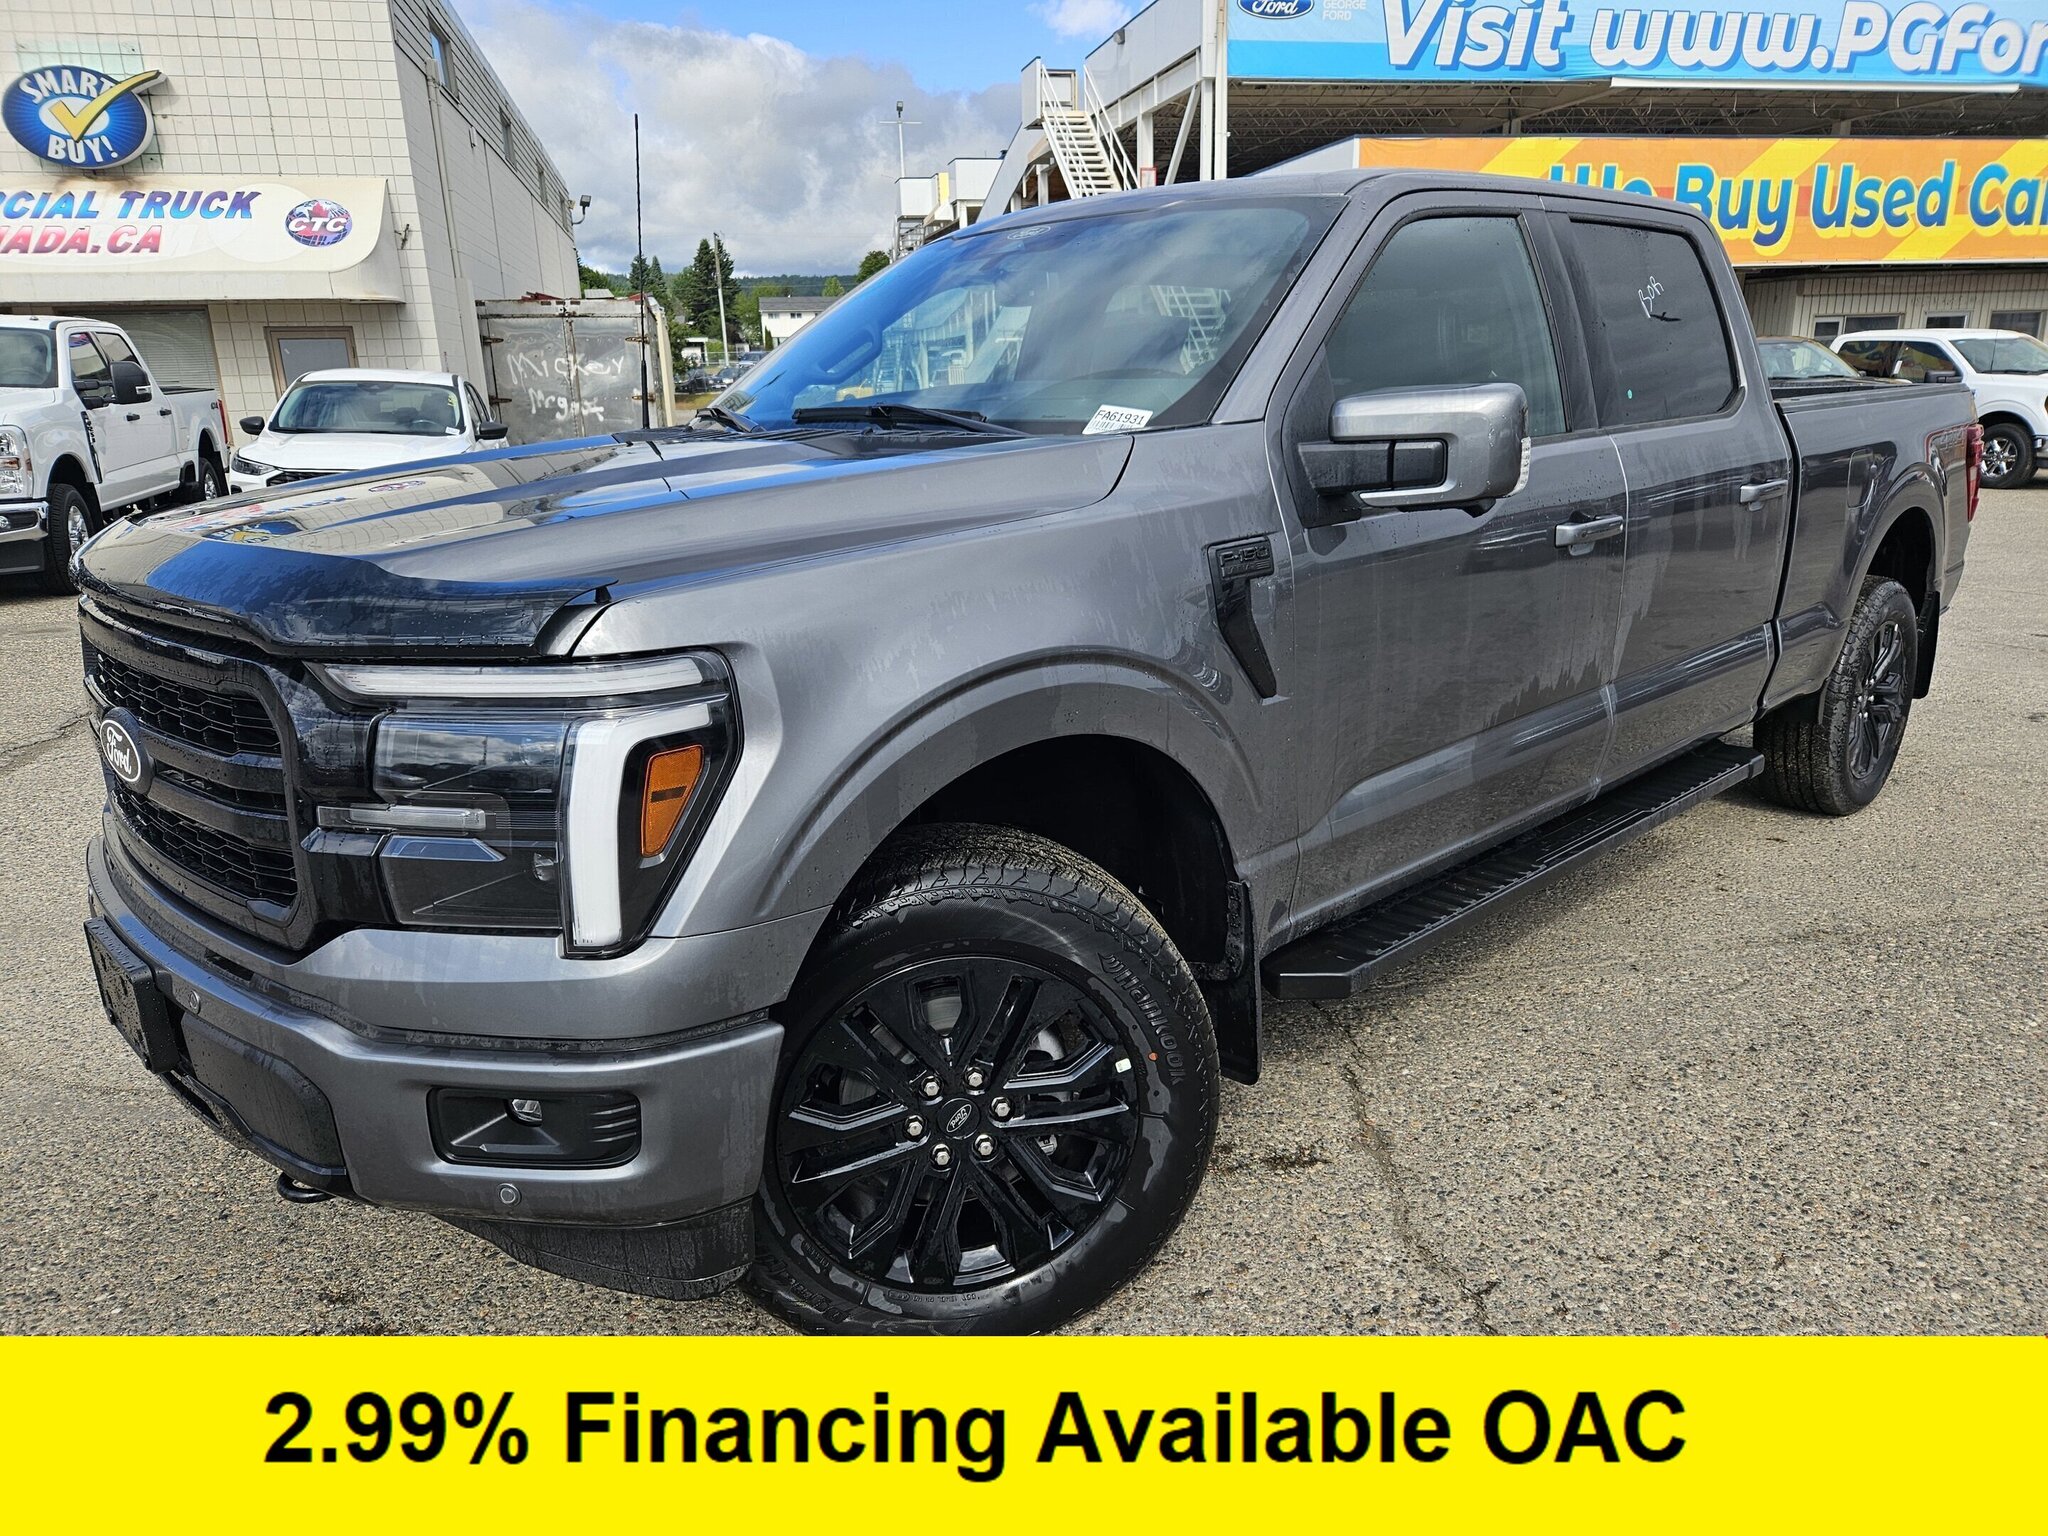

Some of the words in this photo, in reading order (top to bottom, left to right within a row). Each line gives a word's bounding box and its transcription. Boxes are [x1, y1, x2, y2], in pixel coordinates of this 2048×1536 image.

[1322, 10, 1352, 21] FORD
[1382, 0, 1570, 68] Visit
[18, 68, 118, 105] SMART
[47, 134, 118, 164] BUY!
[0, 190, 99, 220] CIAL
[117, 190, 262, 220] TRUCK
[1674, 163, 1794, 247] Buy
[1811, 160, 1957, 229] Used
[288, 216, 348, 233] CTC
[1094, 409, 1146, 425] FA61931
[106, 726, 132, 775] Ford
